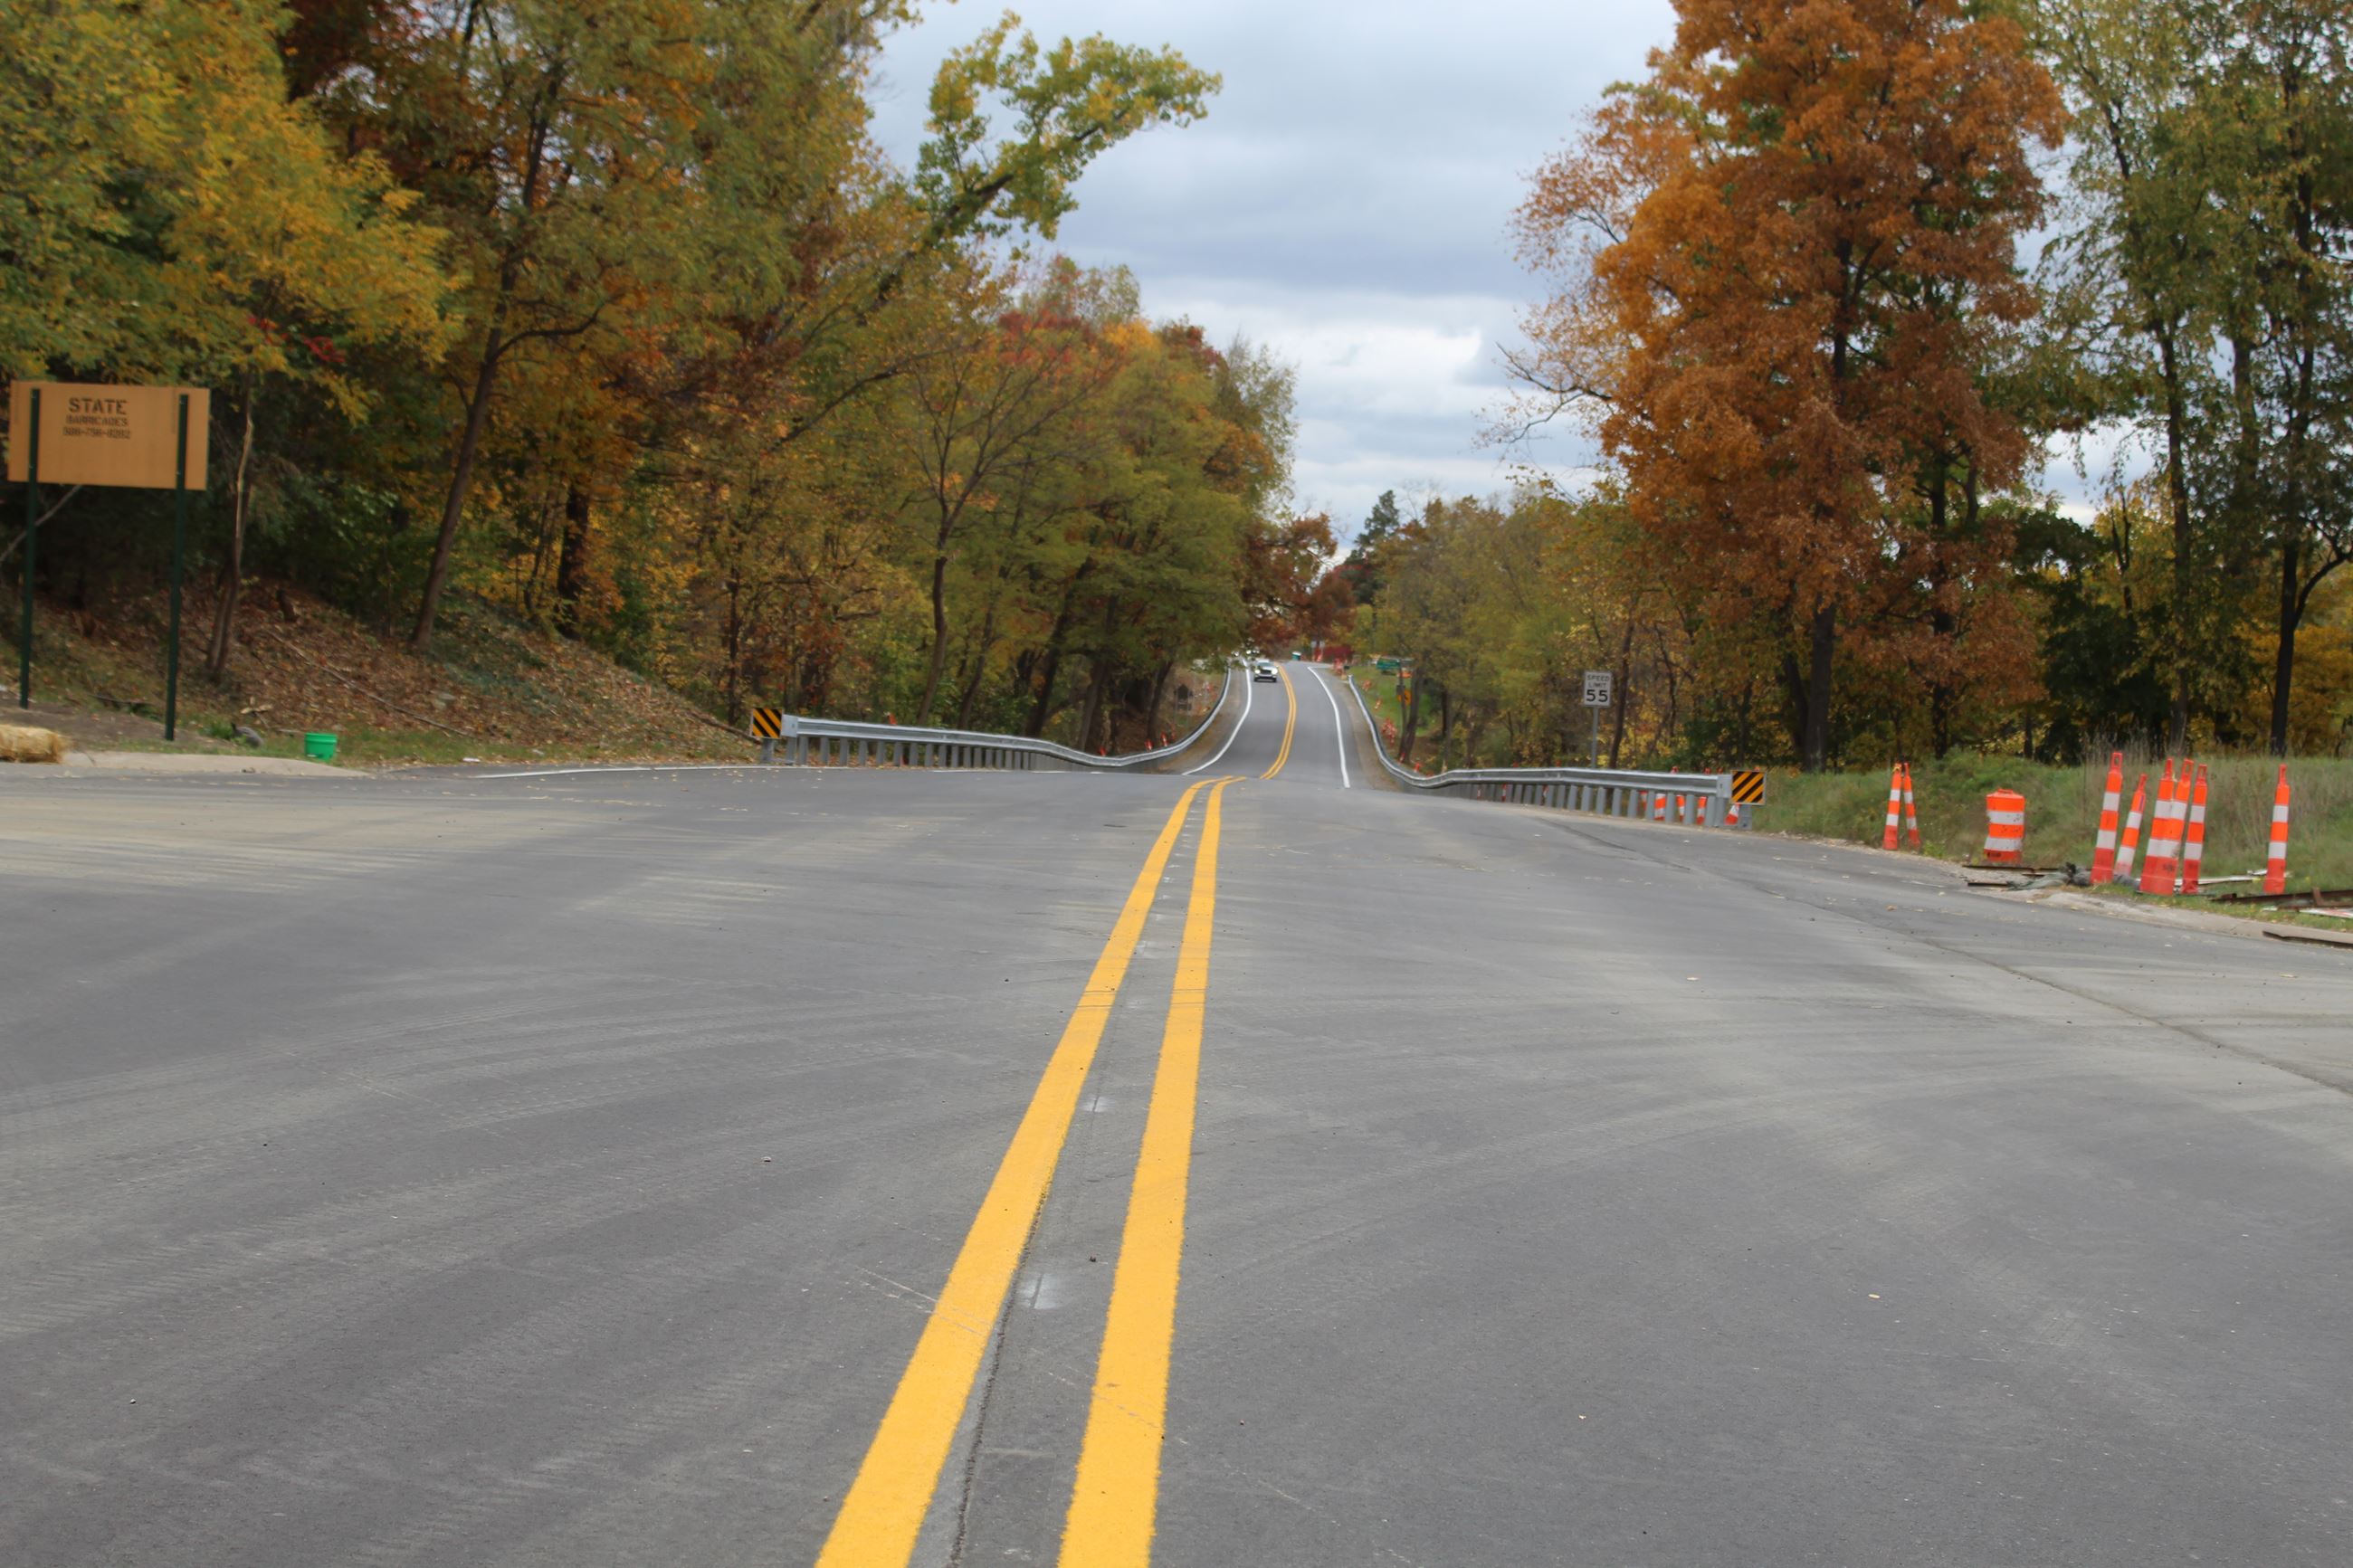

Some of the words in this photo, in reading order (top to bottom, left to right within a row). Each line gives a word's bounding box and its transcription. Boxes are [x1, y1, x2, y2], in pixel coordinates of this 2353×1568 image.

[69, 397, 127, 415] STATE
[66, 414, 129, 427] BARRICADES
[1586, 689, 1608, 702] 55
